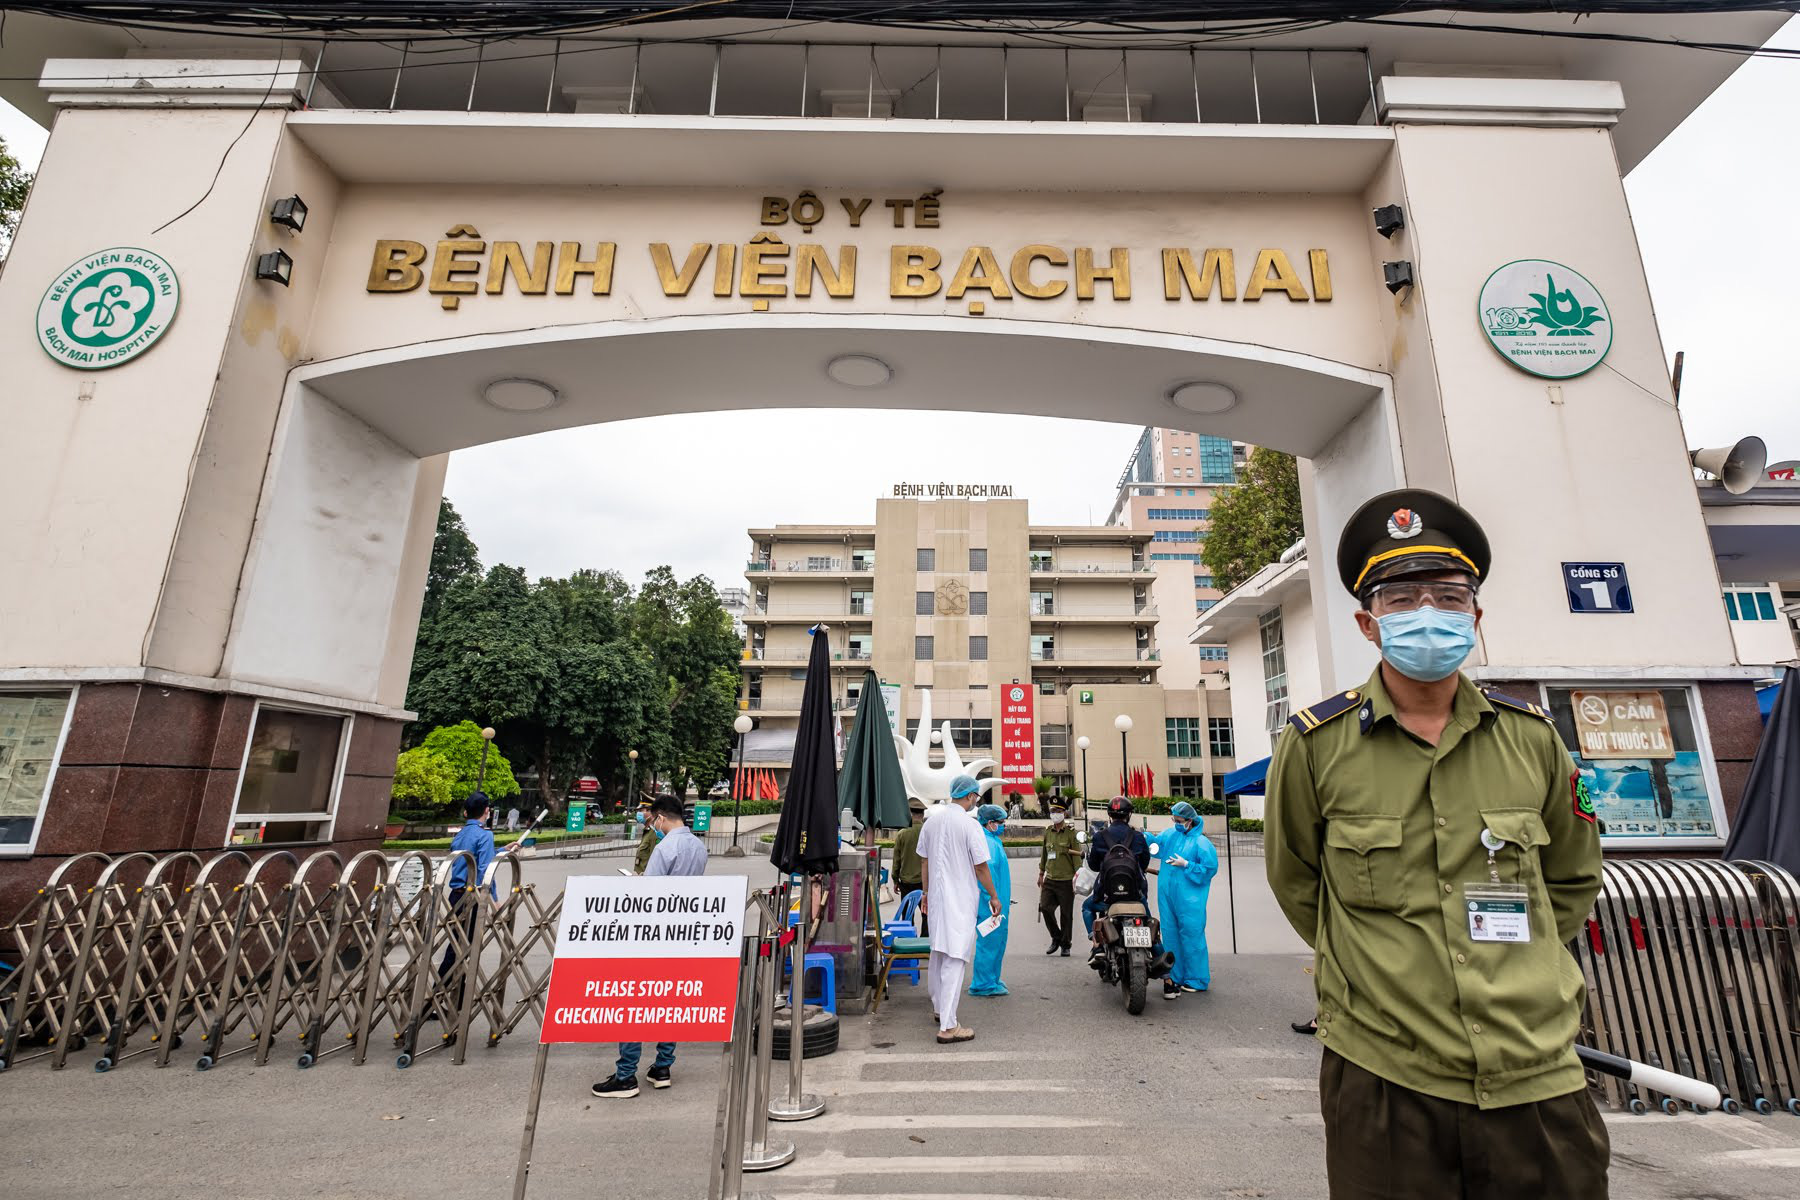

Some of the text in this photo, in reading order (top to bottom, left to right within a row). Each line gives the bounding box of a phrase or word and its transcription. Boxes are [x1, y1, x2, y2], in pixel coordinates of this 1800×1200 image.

[761, 187, 944, 233] BỘ Y TẾ
[50, 254, 172, 301] BỆNH VIỆN BẠCH MAI
[366, 224, 1333, 315] BỆNH VIỆN BẠCH MAI
[45, 324, 160, 362] BACH MAI HOSPITAL
[1511, 348, 1532, 356] BỆNH
[1534, 348, 1553, 356] VIỆN
[893, 481, 1012, 500] BỆNH VIỆN BẠCH MAI
[1570, 565, 1618, 578] CỔNG SỐ
[1580, 581, 1612, 608] 1
[1082, 692, 1090, 702] P
[1614, 699, 1656, 719] CẤM
[1585, 725, 1667, 750] HÚT THUỐC LÁ
[585, 894, 726, 918] VUI LÒNG DỪNG LẠI
[568, 919, 734, 945] ĐỂ KIỂM TRA NHIỆT ĐỘ
[585, 980, 703, 997] PLEASE STOP FOR
[554, 1006, 727, 1024] CHECKING TEMPERATURE
